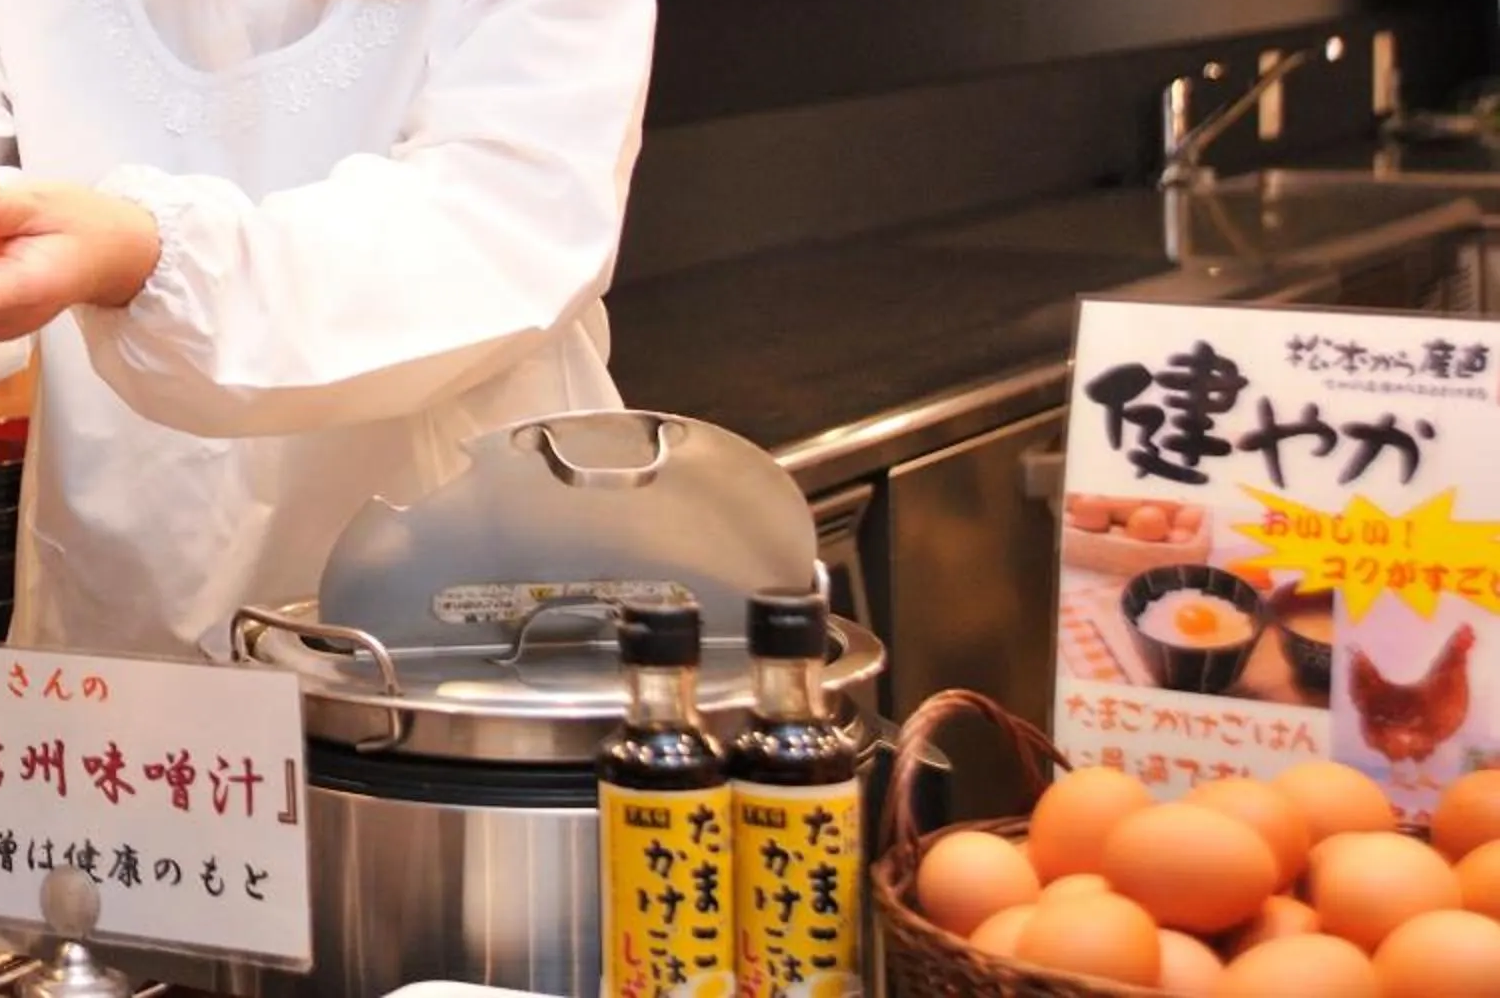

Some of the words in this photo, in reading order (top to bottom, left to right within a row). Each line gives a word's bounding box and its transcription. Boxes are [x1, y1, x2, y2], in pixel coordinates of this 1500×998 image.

[1284, 334, 1490, 379] 松本から産直
[1084, 339, 1437, 490] 健やか
